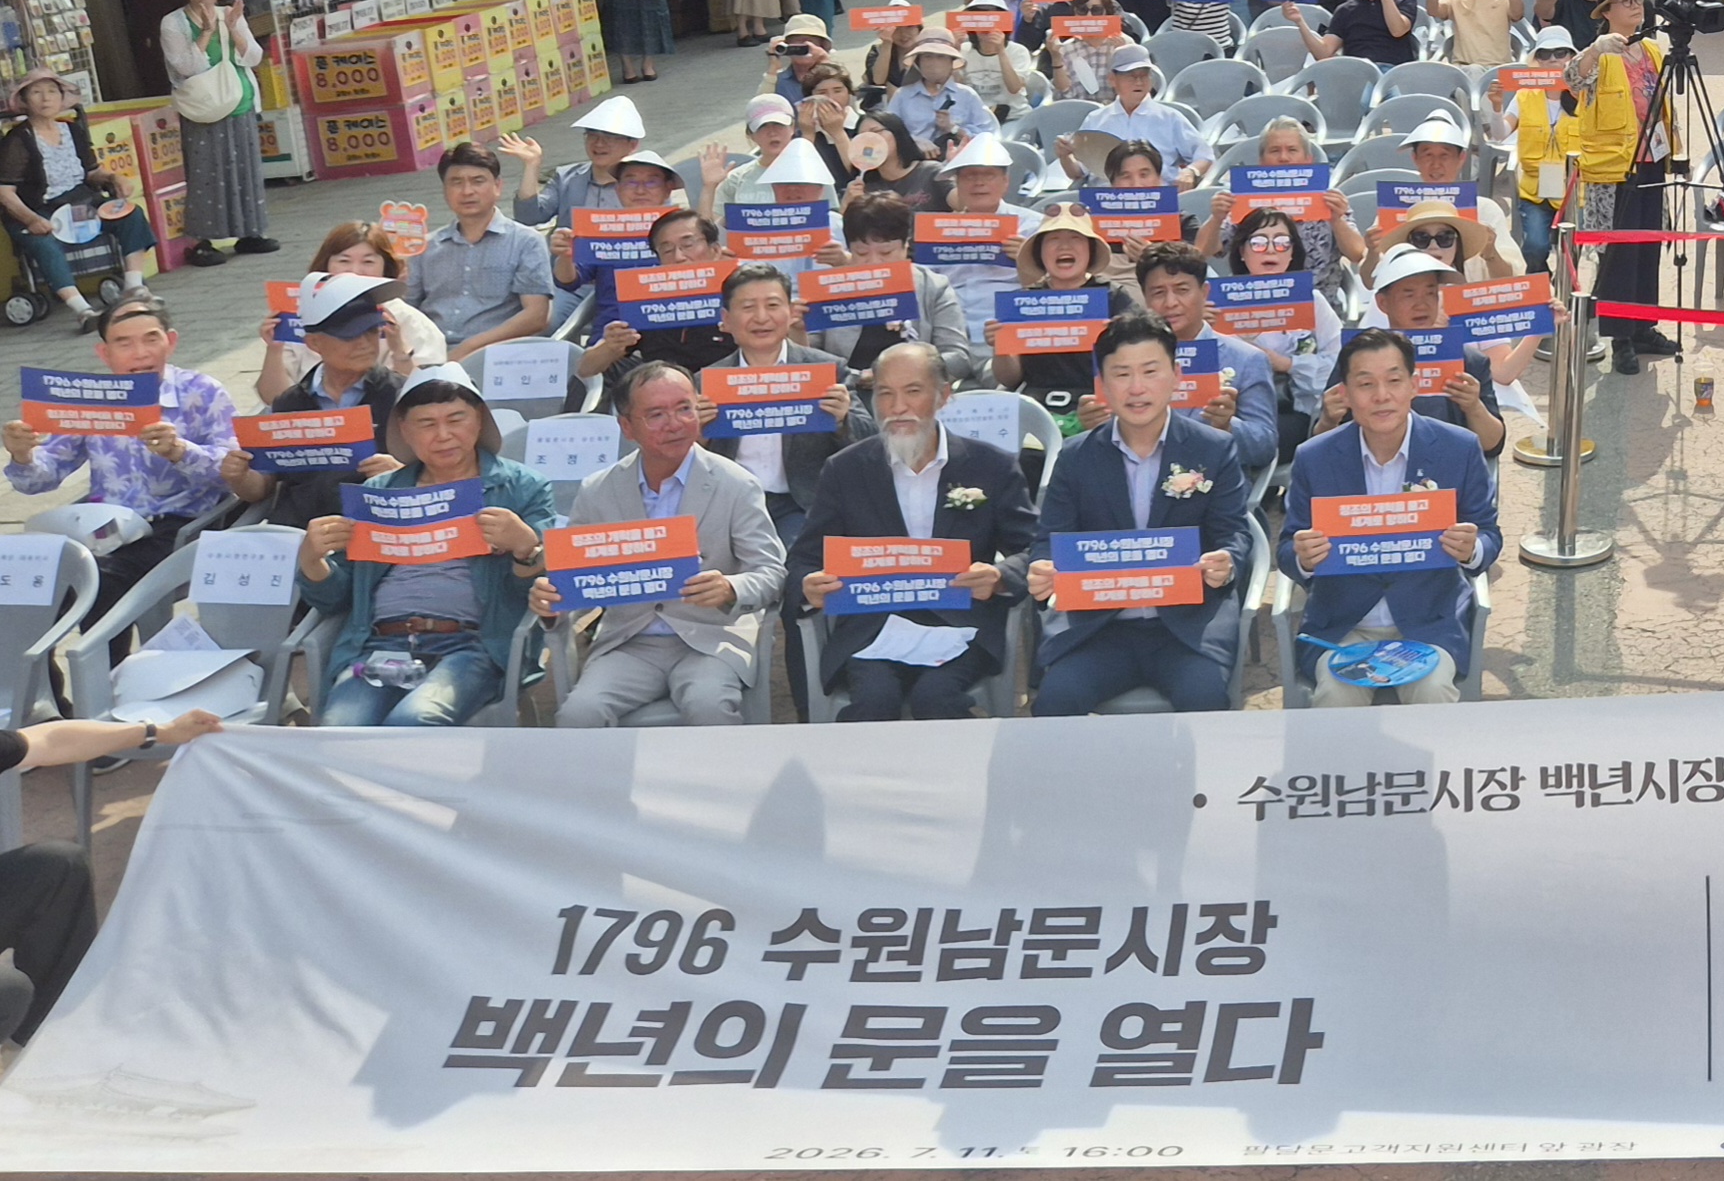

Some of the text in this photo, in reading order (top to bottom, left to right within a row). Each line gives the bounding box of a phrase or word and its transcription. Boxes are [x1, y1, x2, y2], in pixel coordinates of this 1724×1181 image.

[314, 52, 375, 71] 폰 케이스
[315, 67, 379, 89] 8.000
[326, 116, 387, 135] 폰 케이스
[326, 131, 390, 154] 8.000
[574, 573, 607, 586] 1796
[1238, 766, 1526, 822] 수원남문시장
[550, 899, 1279, 983] 1796 수원남문시장
[442, 995, 1326, 1089] 백년의 문을 열다
[763, 1146, 891, 1160] 2026.
[909, 1146, 937, 1159] 7.
[958, 1146, 1005, 1159] 11.
[1062, 1145, 1185, 1159] 16:00
[1243, 1141, 1528, 1157] 팔달문고객지원센터
[1539, 1141, 1568, 1154] 앞
[1579, 1140, 1638, 1153] 광장
